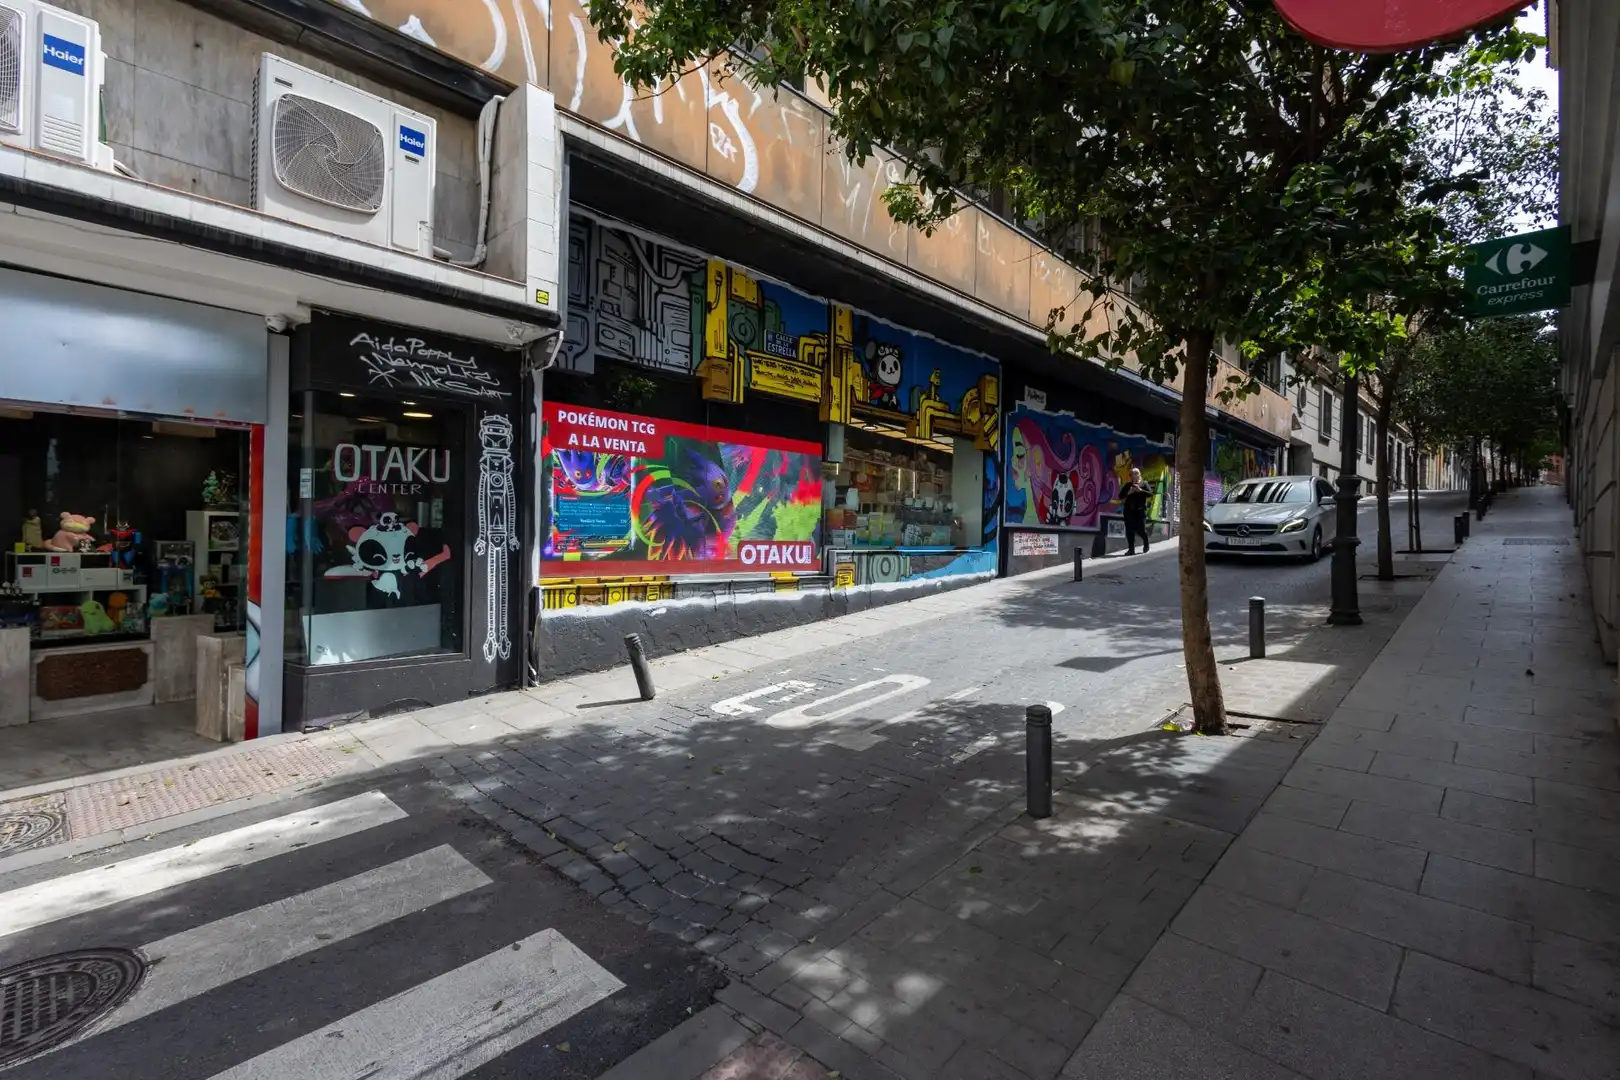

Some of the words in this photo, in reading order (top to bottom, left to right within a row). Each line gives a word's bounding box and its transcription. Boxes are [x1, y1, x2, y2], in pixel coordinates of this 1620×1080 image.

[44, 44, 83, 65] Haier
[400, 133, 424, 148] Haier
[1477, 275, 1556, 296] Carrefour
[1487, 290, 1543, 305] express
[775, 333, 793, 344] CALLE
[767, 342, 797, 358] ESTRELLA
[558, 410, 628, 431] POKÉMON
[631, 421, 655, 435] TCG
[568, 433, 578, 446] A
[582, 435, 600, 448] LA
[603, 437, 646, 453] VENTA
[334, 443, 450, 483] OTAKU
[357, 483, 422, 495] CENTER
[740, 544, 809, 565] OTAKU
